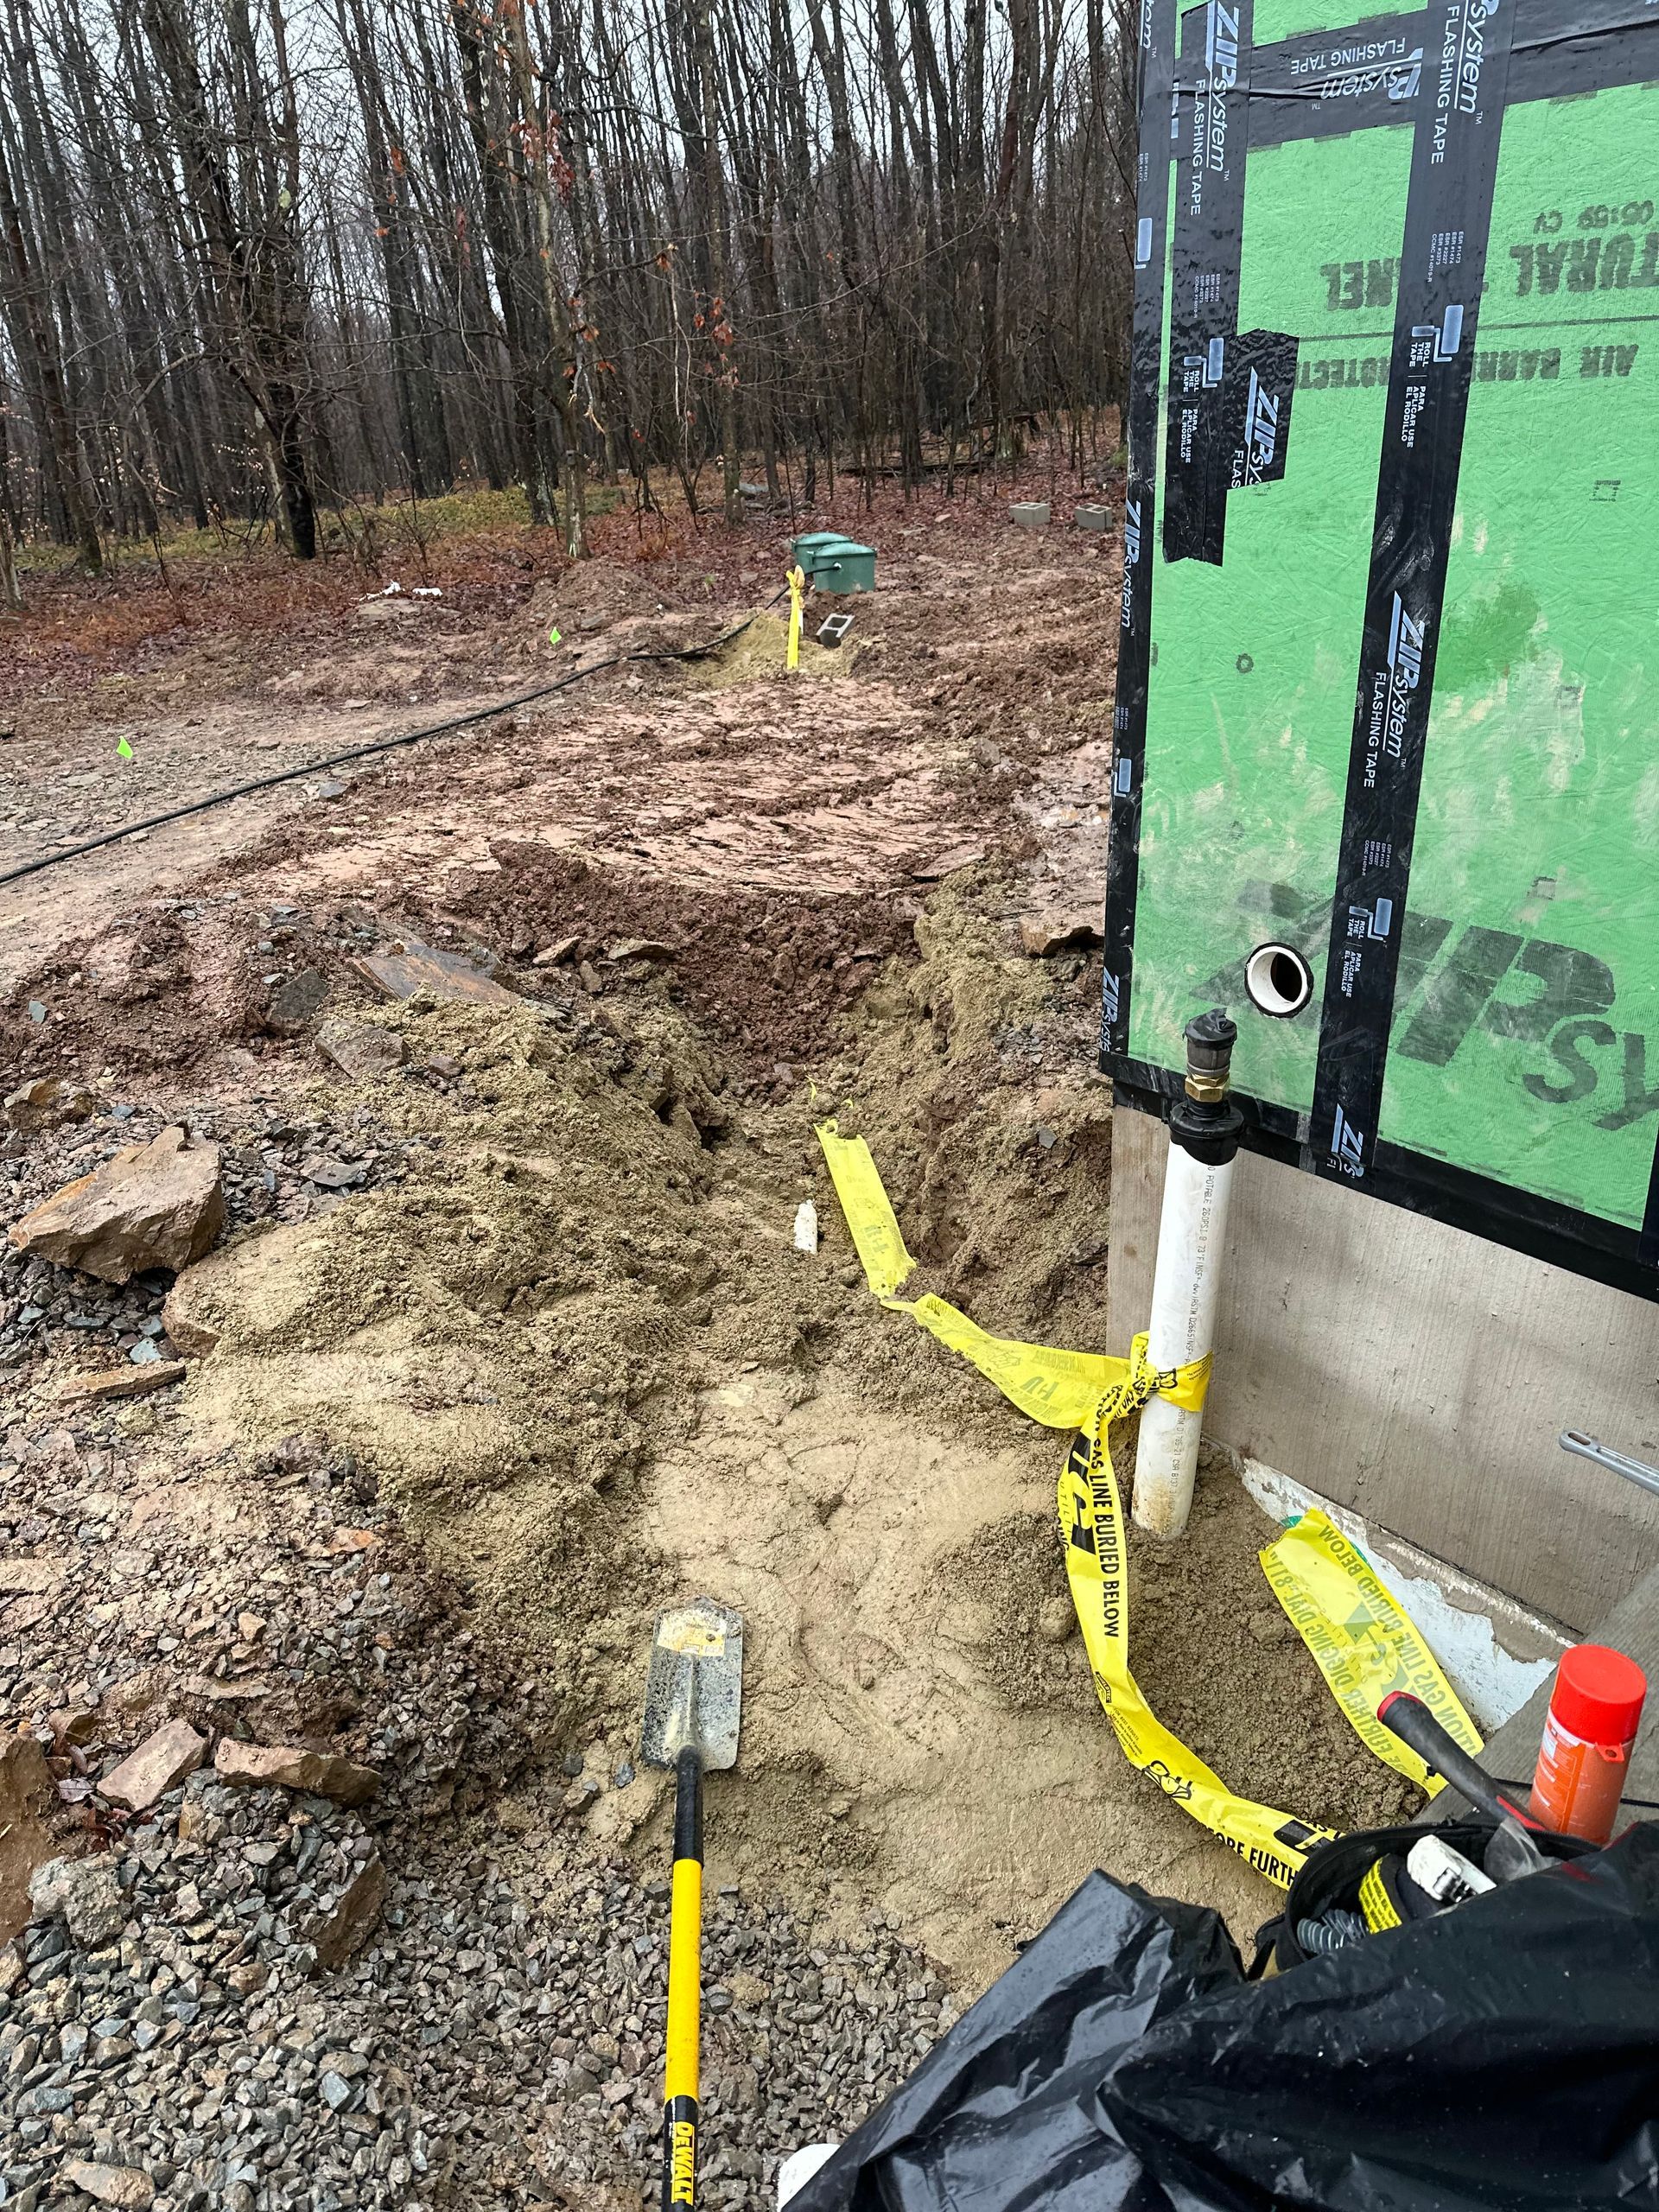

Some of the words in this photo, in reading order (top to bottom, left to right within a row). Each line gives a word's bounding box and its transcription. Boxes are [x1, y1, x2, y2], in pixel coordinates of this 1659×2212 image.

[1216, 2, 1239, 87] ZIP
[1331, 37, 1406, 66] FLASHING
[1437, 5, 1460, 109] FLASHING
[1291, 57, 1327, 75] TAPE
[1192, 79, 1206, 167] FLASHING
[1431, 113, 1449, 165] TAPE
[1191, 171, 1203, 216] TAPE
[1409, 342, 1418, 367] TAPE
[1422, 342, 1432, 367] ROLL
[1580, 344, 1639, 378] AIR
[1406, 386, 1414, 399] EL
[1409, 386, 1420, 428] APLICAR
[1418, 385, 1427, 412] PARA
[1182, 410, 1188, 418] EL
[1255, 385, 1280, 465] ZIP
[1401, 401, 1412, 442] RODILLO
[1125, 498, 1141, 564] ZIP
[1397, 610, 1426, 689] ZIP
[1369, 671, 1387, 747] FLASHING
[1363, 752, 1378, 789] TAPE
[1344, 950, 1351, 960] EL
[1348, 951, 1357, 982] APLICAR
[1103, 966, 1120, 1023] ZIP
[1341, 961, 1350, 992] RODILLO
[1203, 1175, 1215, 1205] POTABLE
[1200, 1207, 1211, 1233] 260PSI
[1090, 1474, 1112, 1508] LINE
[1095, 1514, 1121, 1575] BURIED
[1103, 1580, 1120, 1638] BELOW
[1249, 1847, 1299, 1887] FURTH
